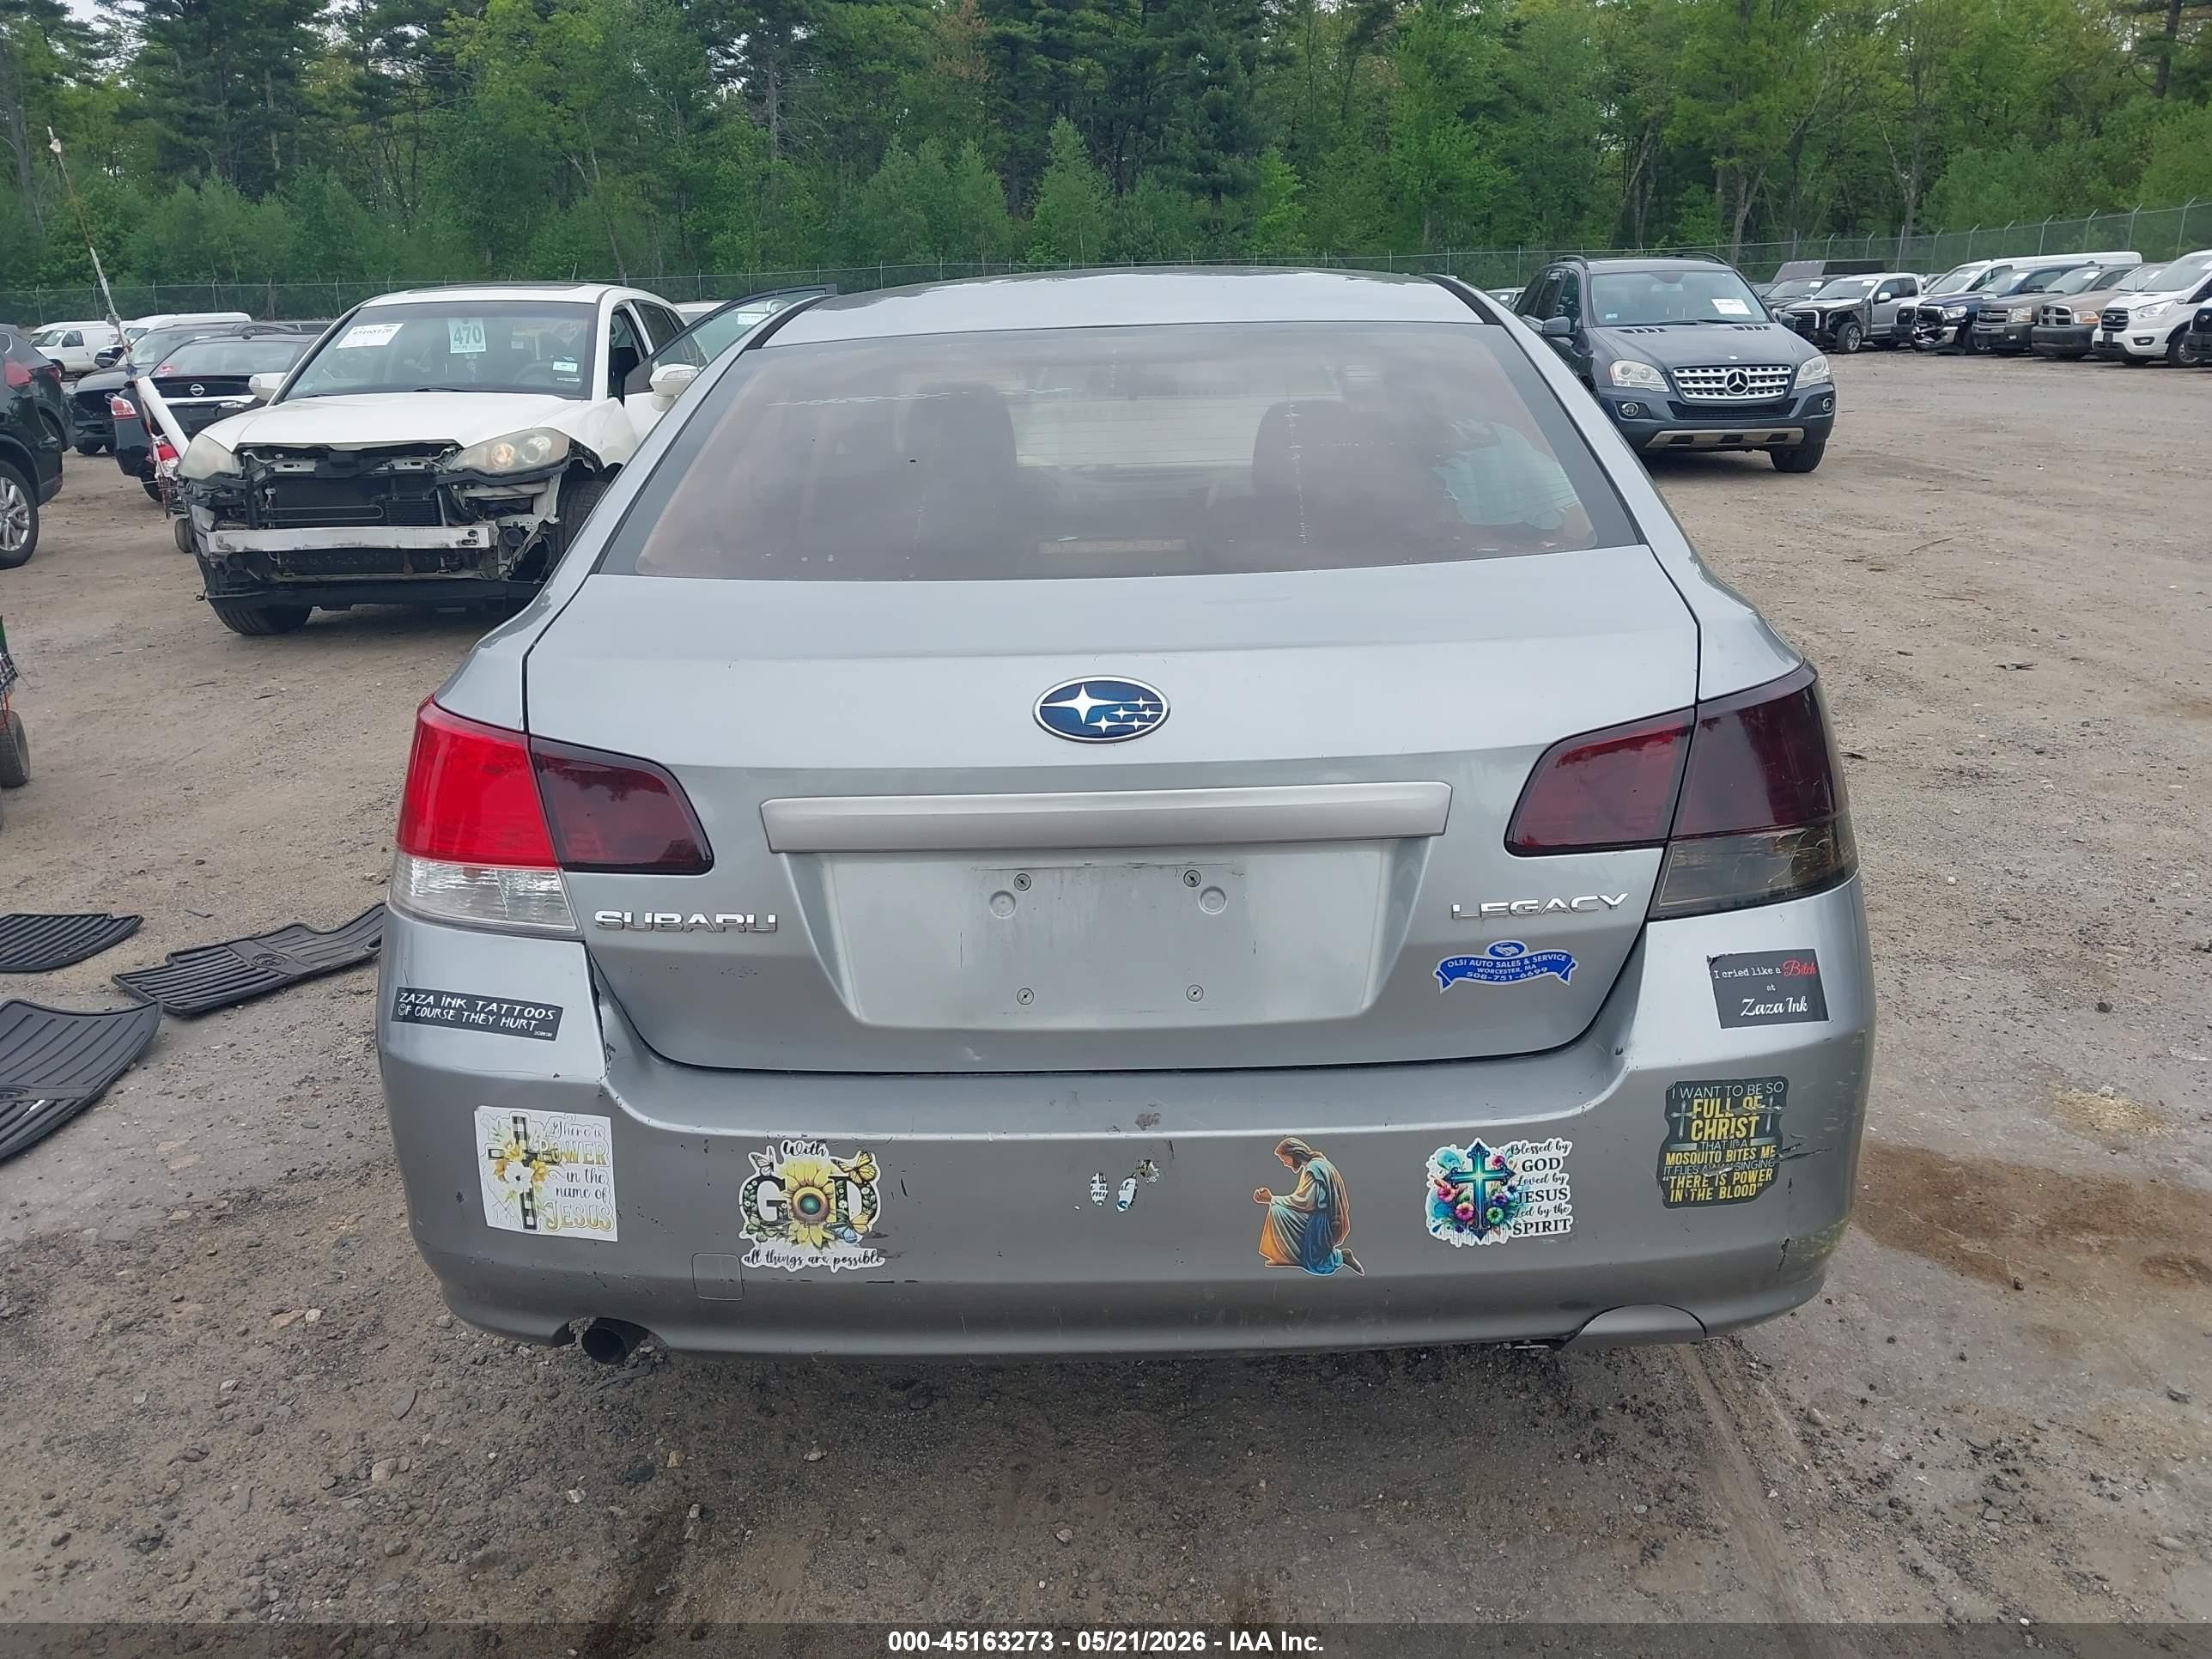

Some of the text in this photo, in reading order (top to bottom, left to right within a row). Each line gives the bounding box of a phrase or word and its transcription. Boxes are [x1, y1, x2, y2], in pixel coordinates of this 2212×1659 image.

[453, 326, 483, 344] 470
[1451, 892, 1629, 920] LEGACY
[594, 910, 777, 933] SUBARU
[1447, 959, 1467, 968] OLSI
[1469, 959, 1493, 968] AUTO
[1495, 959, 1522, 969] SALES
[1533, 953, 1567, 963] SERVICE
[1466, 966, 1548, 981] 508-751-6699
[1714, 970, 1720, 979] I
[1722, 968, 1750, 978] cried
[1752, 967, 1774, 976] like
[398, 993, 434, 1005] ZAZA
[475, 1000, 556, 1020] TATTOOS
[1741, 995, 1808, 1017] Zaza Ink
[414, 1006, 456, 1021] COURSE
[461, 1012, 496, 1025] THEY
[500, 1017, 539, 1031] HURT
[1672, 1081, 1784, 1100] I WANT TO BE SO
[1692, 1097, 1735, 1119] FULL
[552, 1121, 602, 1139] There is
[1691, 1116, 1760, 1141] CHRIST
[538, 1139, 607, 1165] POWER
[781, 1141, 827, 1157] With
[1510, 1140, 1570, 1155] Blessed by
[1700, 1140, 1728, 1151] THAT
[1665, 1145, 1778, 1166] MOSQUITO BITES ME
[1522, 1158, 1561, 1172] GOD
[1663, 1165, 1671, 1176] IT
[1674, 1165, 1699, 1176] FLIES
[1735, 1158, 1776, 1171] SINGING
[566, 1168, 605, 1184] in the
[1516, 1172, 1566, 1186] Loved by
[1715, 1173, 1727, 1187] IS
[1733, 1168, 1773, 1185] POWER
[556, 1187, 607, 1201] name of
[1515, 1188, 1568, 1205] JESUS
[1669, 1189, 1684, 1202] IN
[1690, 1188, 1714, 1201] THE
[544, 1200, 615, 1231] JESUS
[1514, 1202, 1570, 1218] Led by the
[1512, 1218, 1571, 1236] SPIRIT
[744, 1249, 883, 1270] all things are possible
